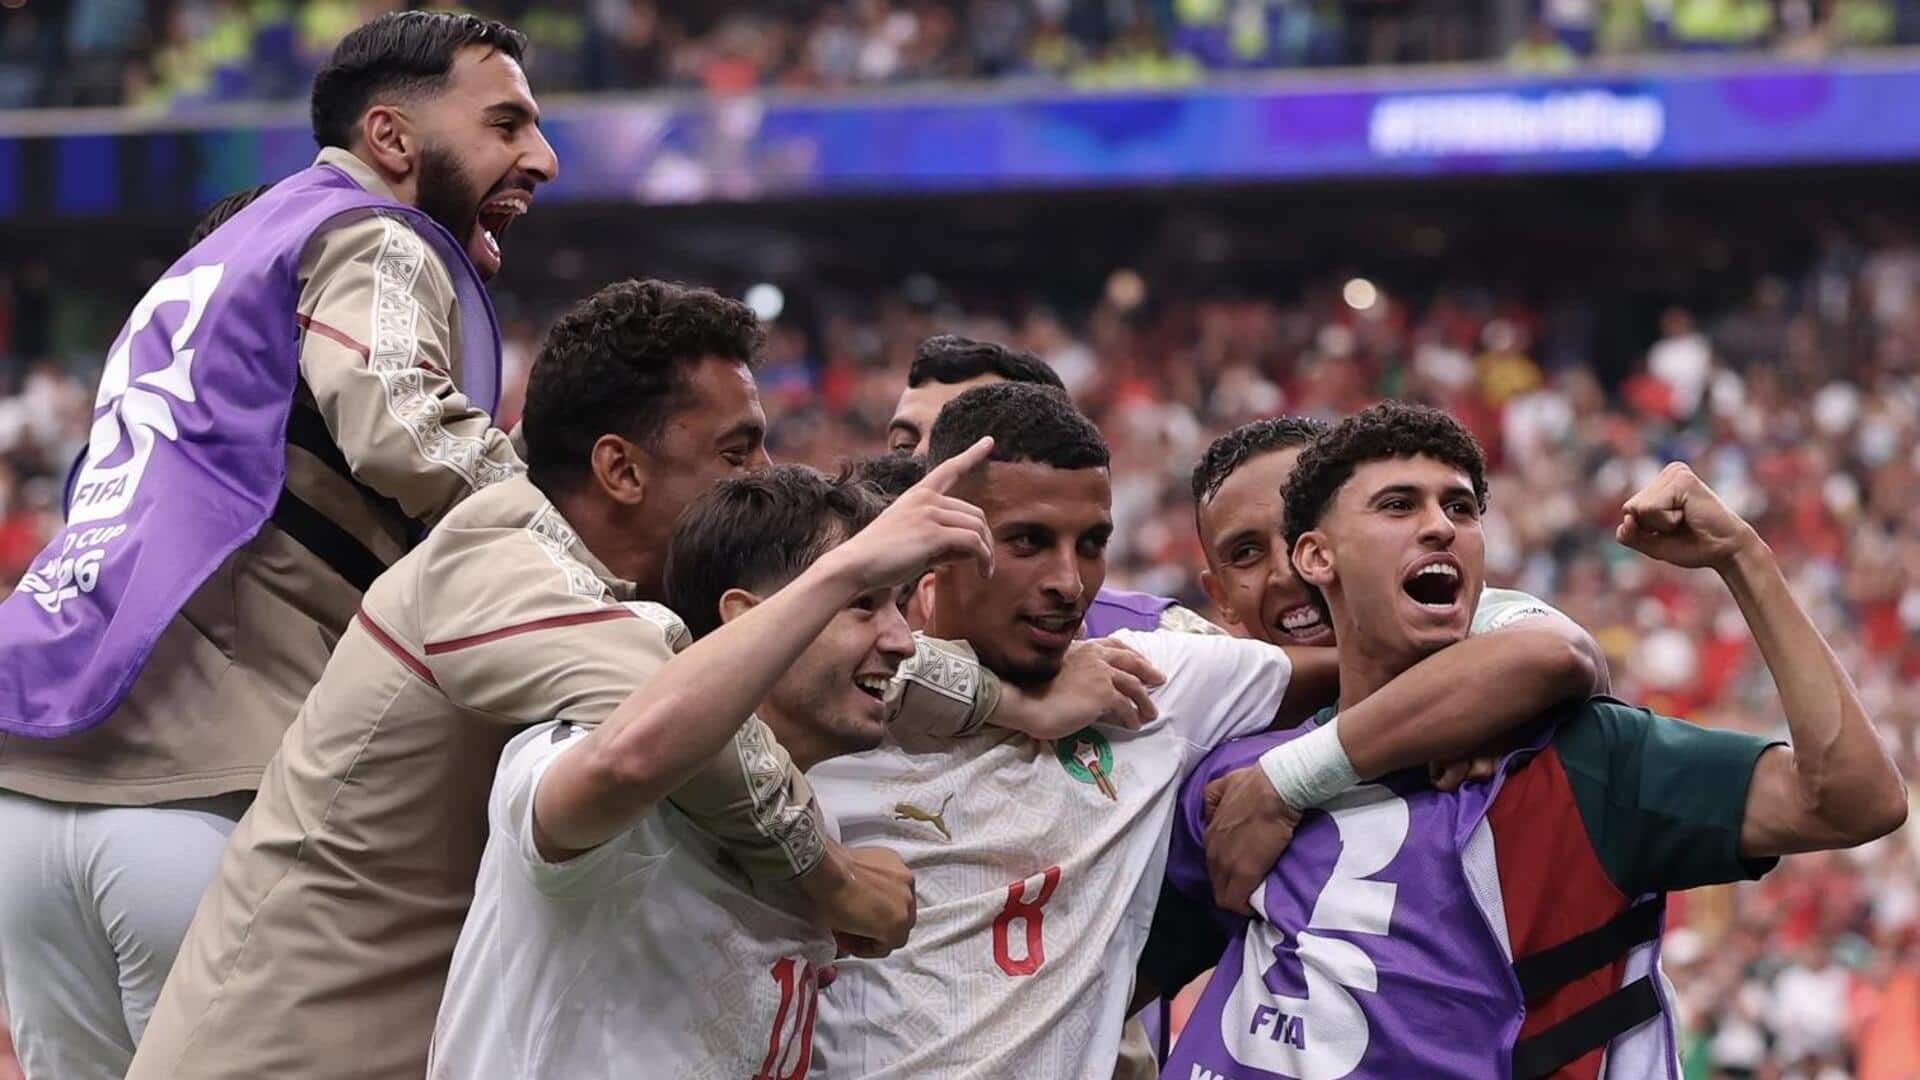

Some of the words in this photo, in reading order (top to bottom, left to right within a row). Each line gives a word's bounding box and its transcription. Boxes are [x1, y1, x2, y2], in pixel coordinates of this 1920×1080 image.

[74, 474, 129, 507] FIFA
[75, 523, 127, 549] CUP
[992, 865, 1061, 977] 8
[752, 956, 819, 1080] 10
